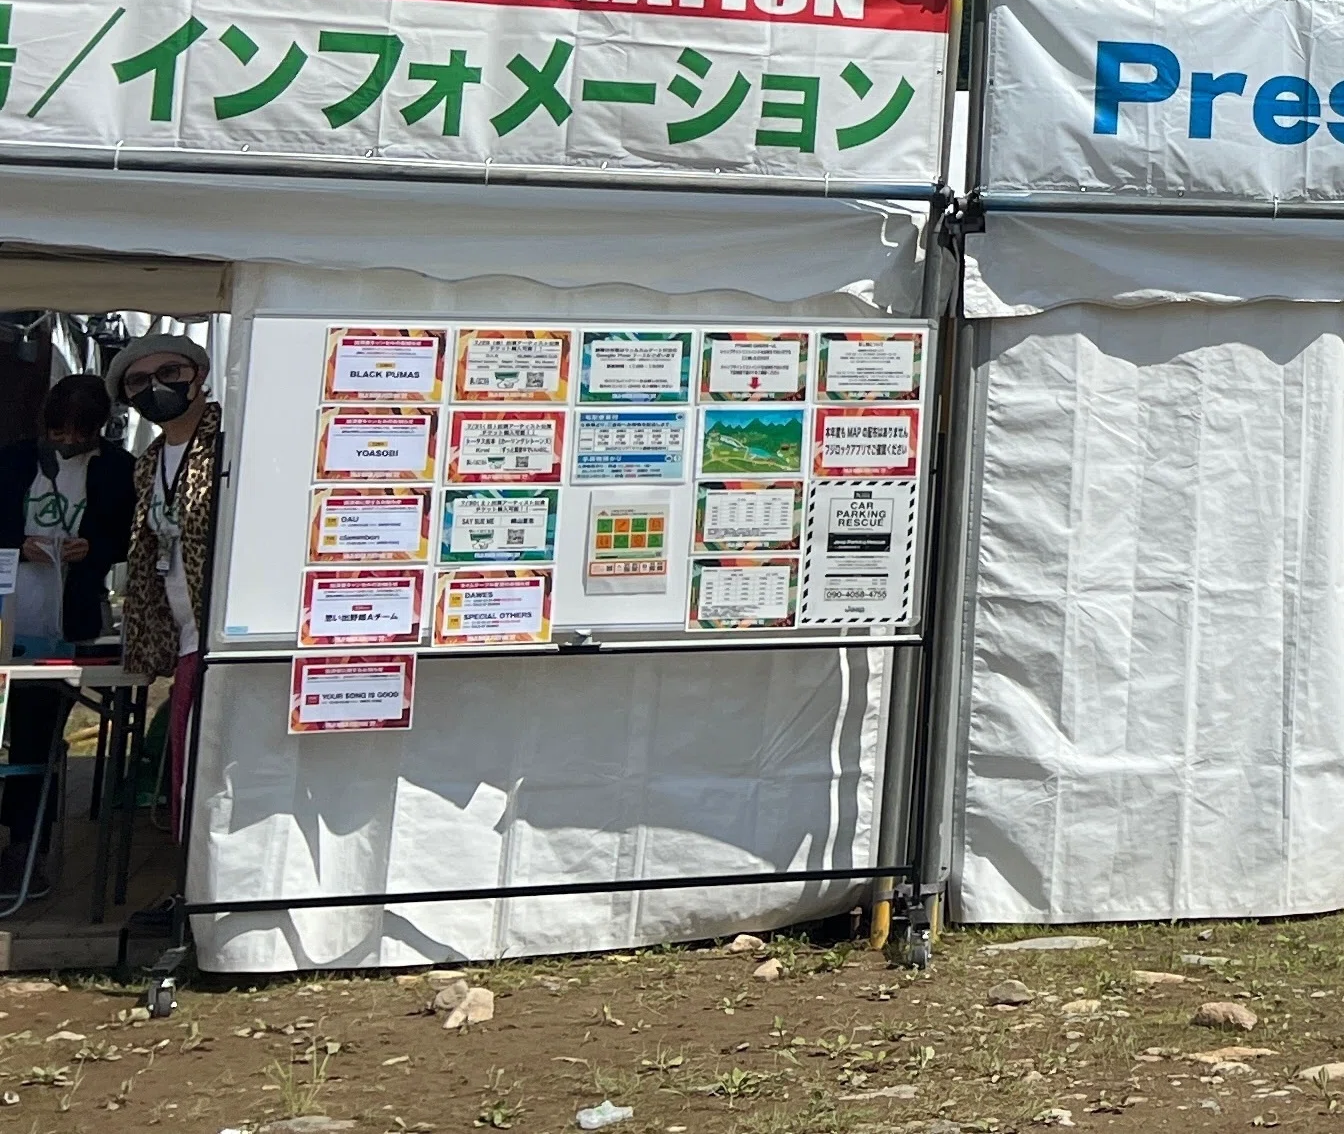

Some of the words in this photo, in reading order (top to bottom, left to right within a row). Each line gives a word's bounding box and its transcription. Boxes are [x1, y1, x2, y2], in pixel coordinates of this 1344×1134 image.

[350, 370, 383, 379] BLACK
[386, 370, 420, 379] PUMAS
[356, 449, 399, 457] YOASOBI
[850, 501, 874, 510] CAR
[836, 510, 887, 519] PARKING
[838, 518, 884, 527] RESCUE
[463, 613, 497, 621] SPECIAL
